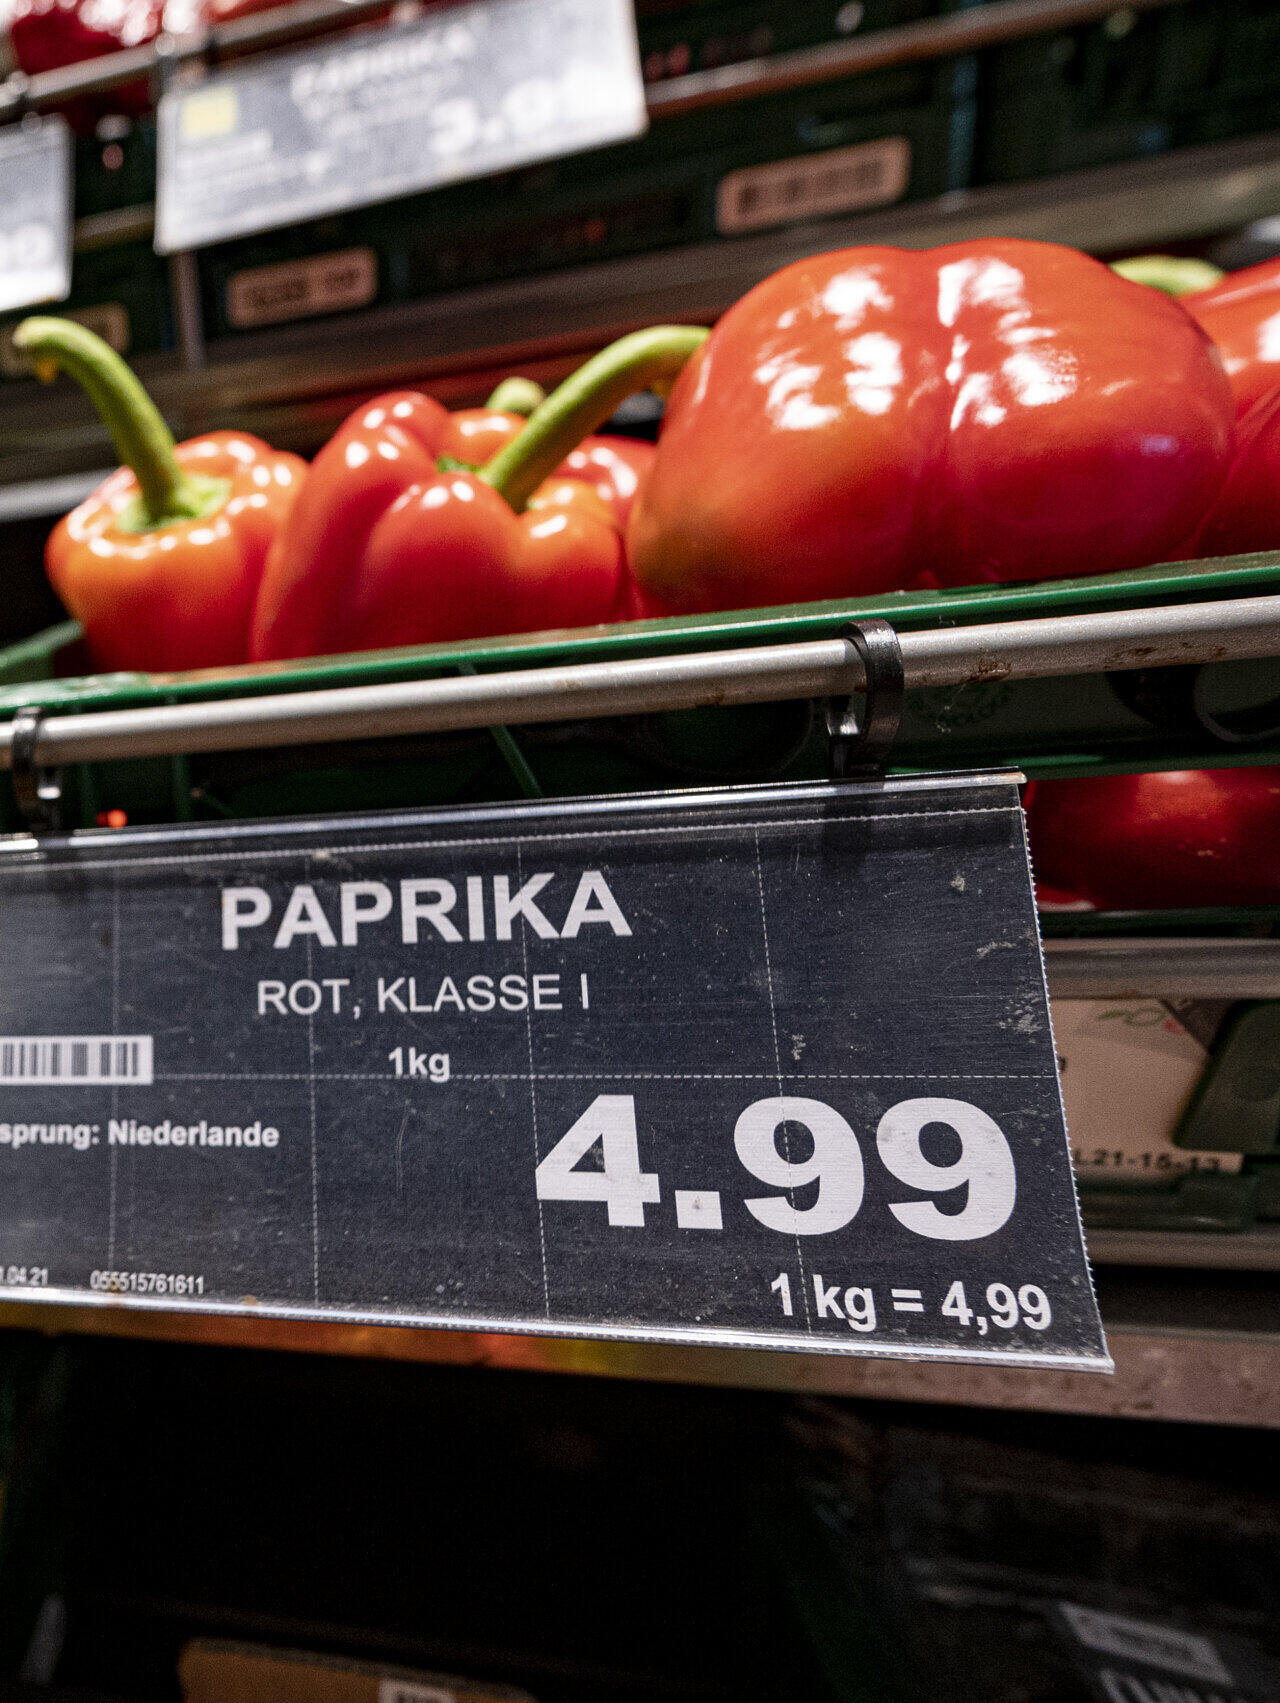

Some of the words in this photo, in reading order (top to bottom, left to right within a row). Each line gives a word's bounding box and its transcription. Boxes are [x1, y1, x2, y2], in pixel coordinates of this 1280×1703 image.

[221, 870, 633, 951] PAPRIKA
[257, 978, 361, 1019] ROT,
[377, 973, 563, 1013] KLASSE
[580, 973, 590, 1010] I
[388, 1046, 452, 1084] 1kg
[107, 1118, 280, 1149] Niederlande
[534, 1094, 1017, 1242] 4.99
[770, 1272, 794, 1317] 1
[812, 1273, 877, 1333] kg
[940, 1280, 1052, 1336] 4,99
